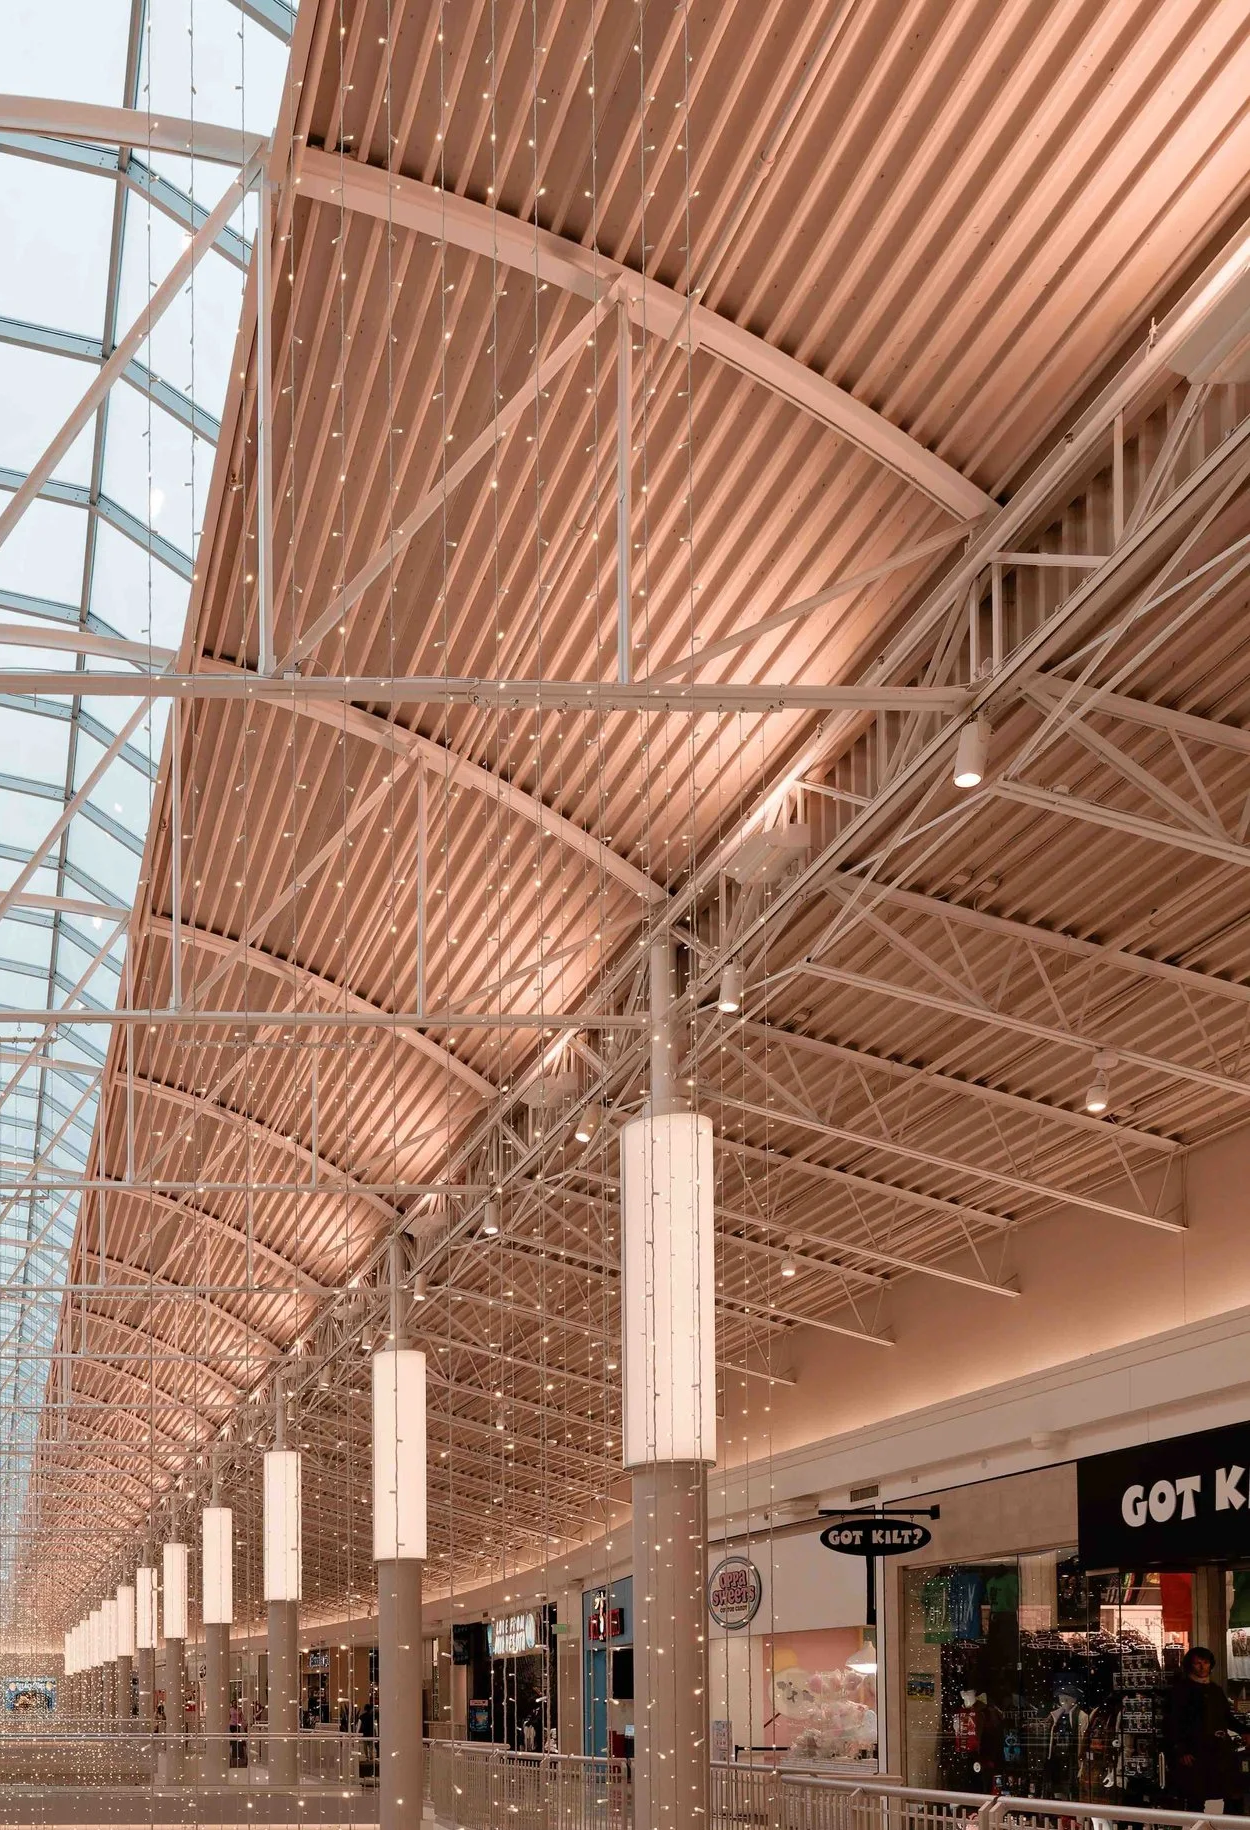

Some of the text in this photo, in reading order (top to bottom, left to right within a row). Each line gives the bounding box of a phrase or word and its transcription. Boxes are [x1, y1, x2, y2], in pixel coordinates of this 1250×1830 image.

[1121, 1464, 1250, 1528] GOT K
[828, 1528, 923, 1545] GOT KILT?
